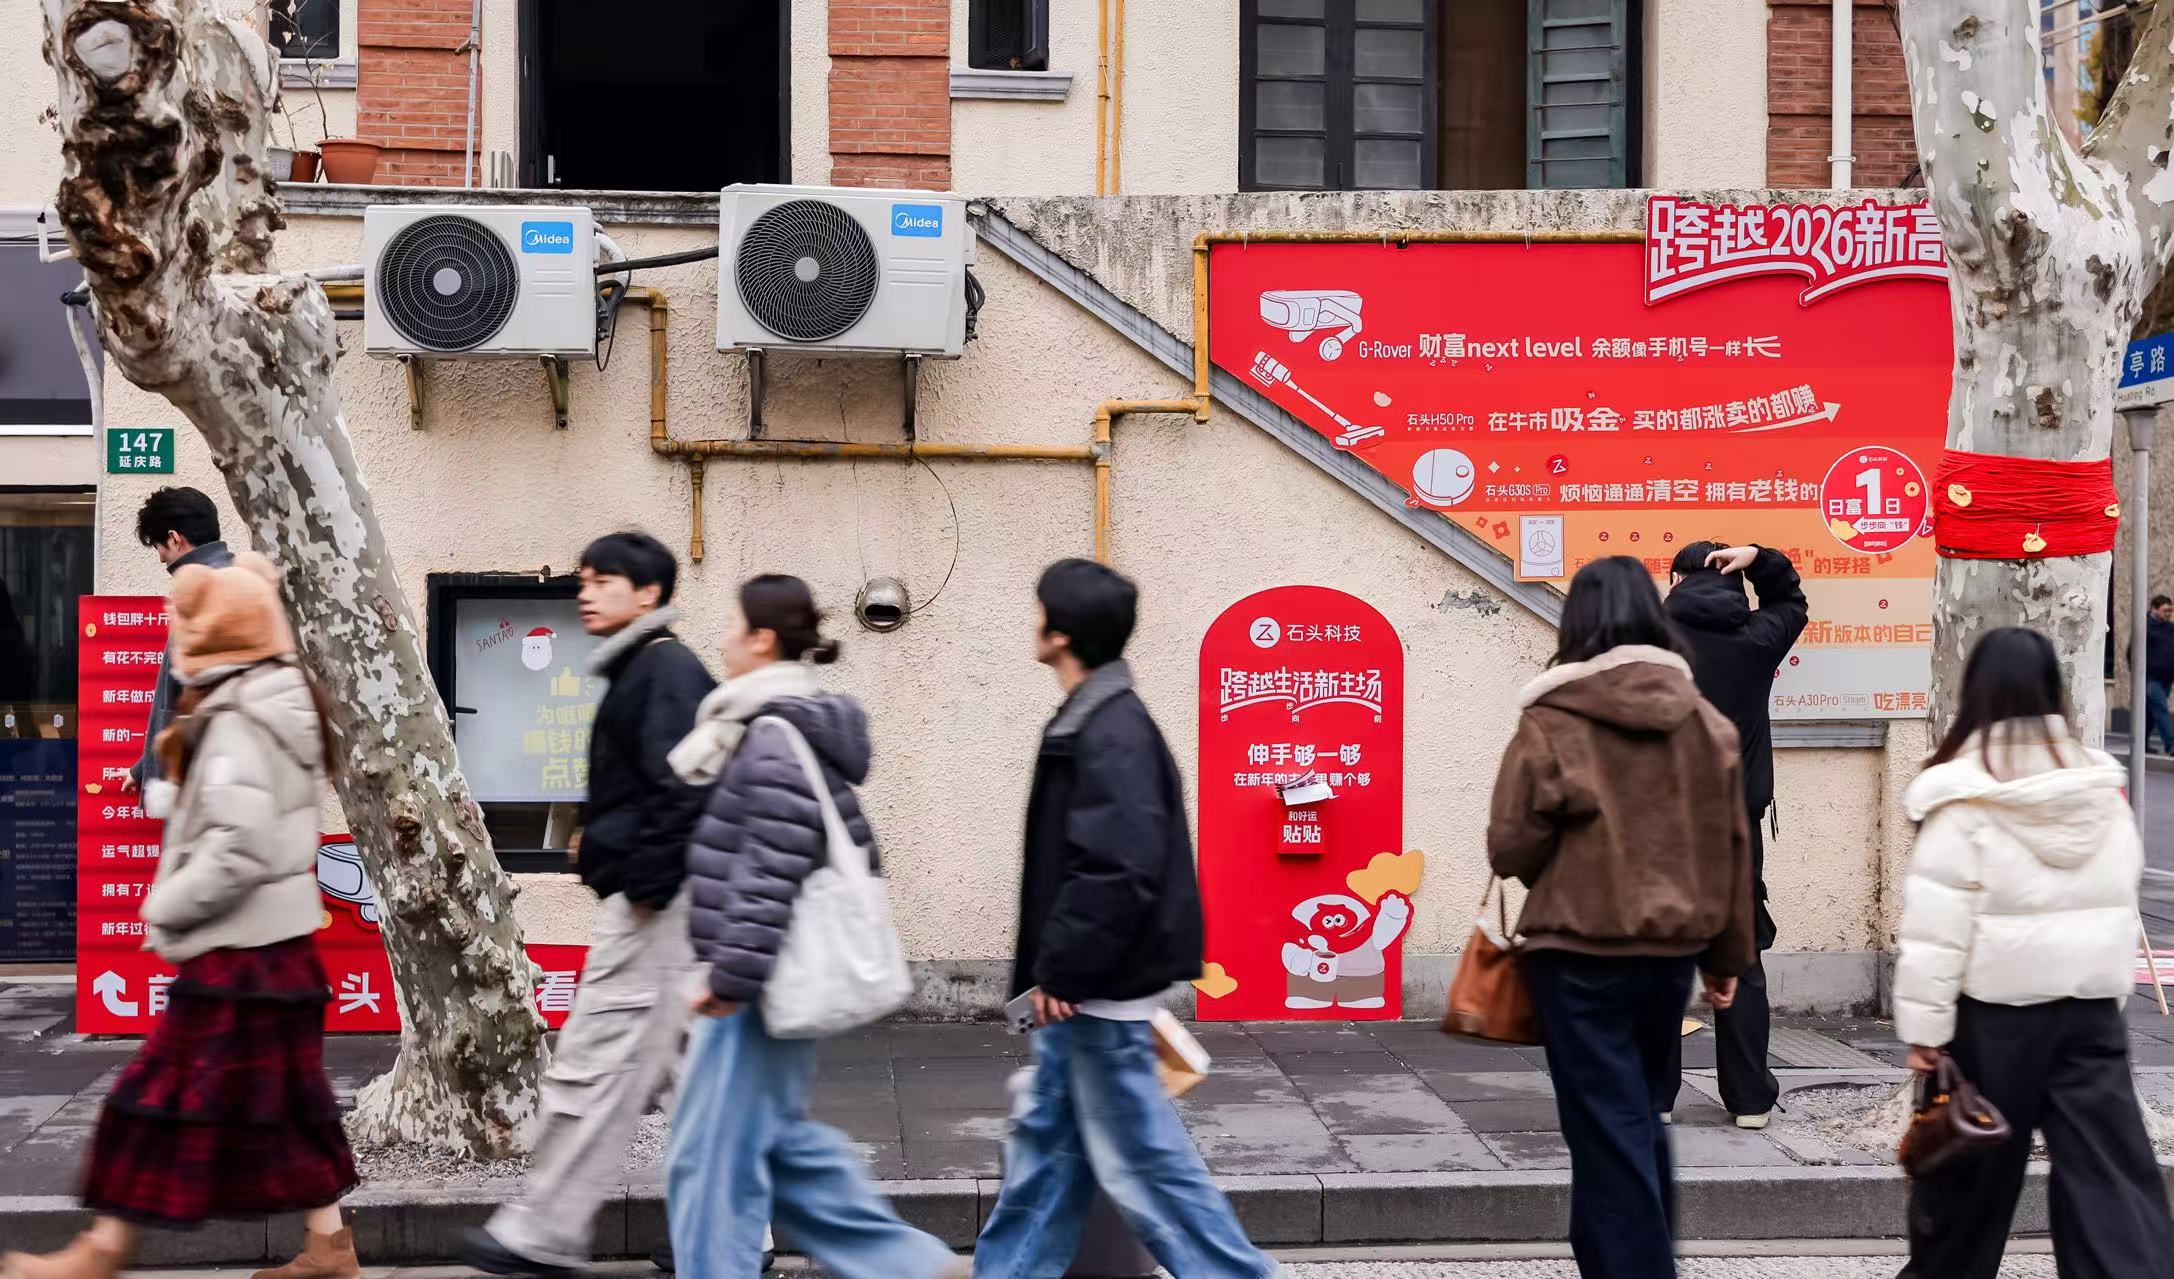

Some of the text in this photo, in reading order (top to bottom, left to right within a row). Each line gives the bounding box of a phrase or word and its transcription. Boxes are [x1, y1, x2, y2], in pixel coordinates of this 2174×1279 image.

[895, 212, 939, 229] Midea
[525, 229, 570, 246] Midea
[1650, 201, 1947, 283] 跨越2026新高
[1359, 333, 1782, 358] G-Rover 财富next level 余额像手机号一样长
[2129, 344, 2166, 379] 亭路
[2145, 386, 2155, 397] Rd
[1406, 384, 1818, 432] 石头H50 Pro 在牛市吸金 买的都涨卖的都赚
[119, 432, 163, 452] 147
[118, 455, 162, 468] 延庆路
[1485, 478, 1819, 503] 石头G30S Pro 烦恼通通清空 拥有老钱的
[103, 612, 170, 626] 钱包胖十斤
[476, 630, 510, 652] SANTA
[1286, 624, 1362, 642] 石头科技
[1796, 620, 1933, 644] 新版本的自己
[1220, 666, 1382, 705] 跨越生活新主场
[1873, 692, 1927, 711] 吃漂亮
[103, 729, 150, 742] 新的一
[1247, 743, 1362, 767] 伸手够一够
[102, 806, 153, 819] 今年有
[1288, 811, 1318, 822] 和好运
[1283, 825, 1321, 843] 贴贴
[101, 845, 160, 858] 运气超爆
[338, 972, 381, 1014] 头
[536, 970, 577, 1012] 看
